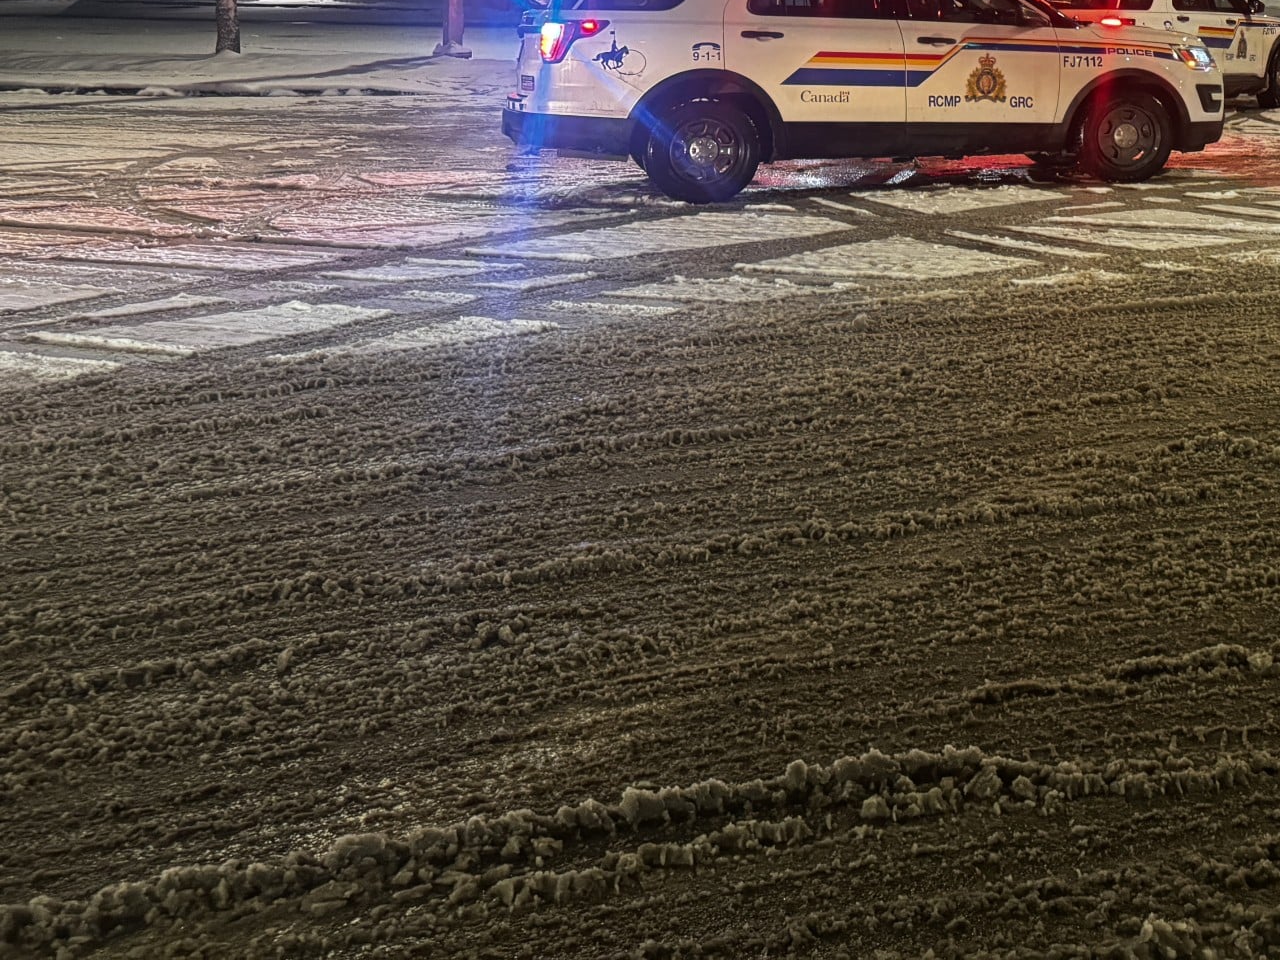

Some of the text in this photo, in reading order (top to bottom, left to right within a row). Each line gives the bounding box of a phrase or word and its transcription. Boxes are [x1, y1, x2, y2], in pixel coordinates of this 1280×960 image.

[692, 51, 721, 61] 9-1-1
[1107, 47, 1154, 57] POLICE
[1063, 55, 1103, 68] FJ7112
[800, 90, 850, 103] Canada
[928, 95, 961, 108] RCMP
[1009, 96, 1034, 109] GRC
